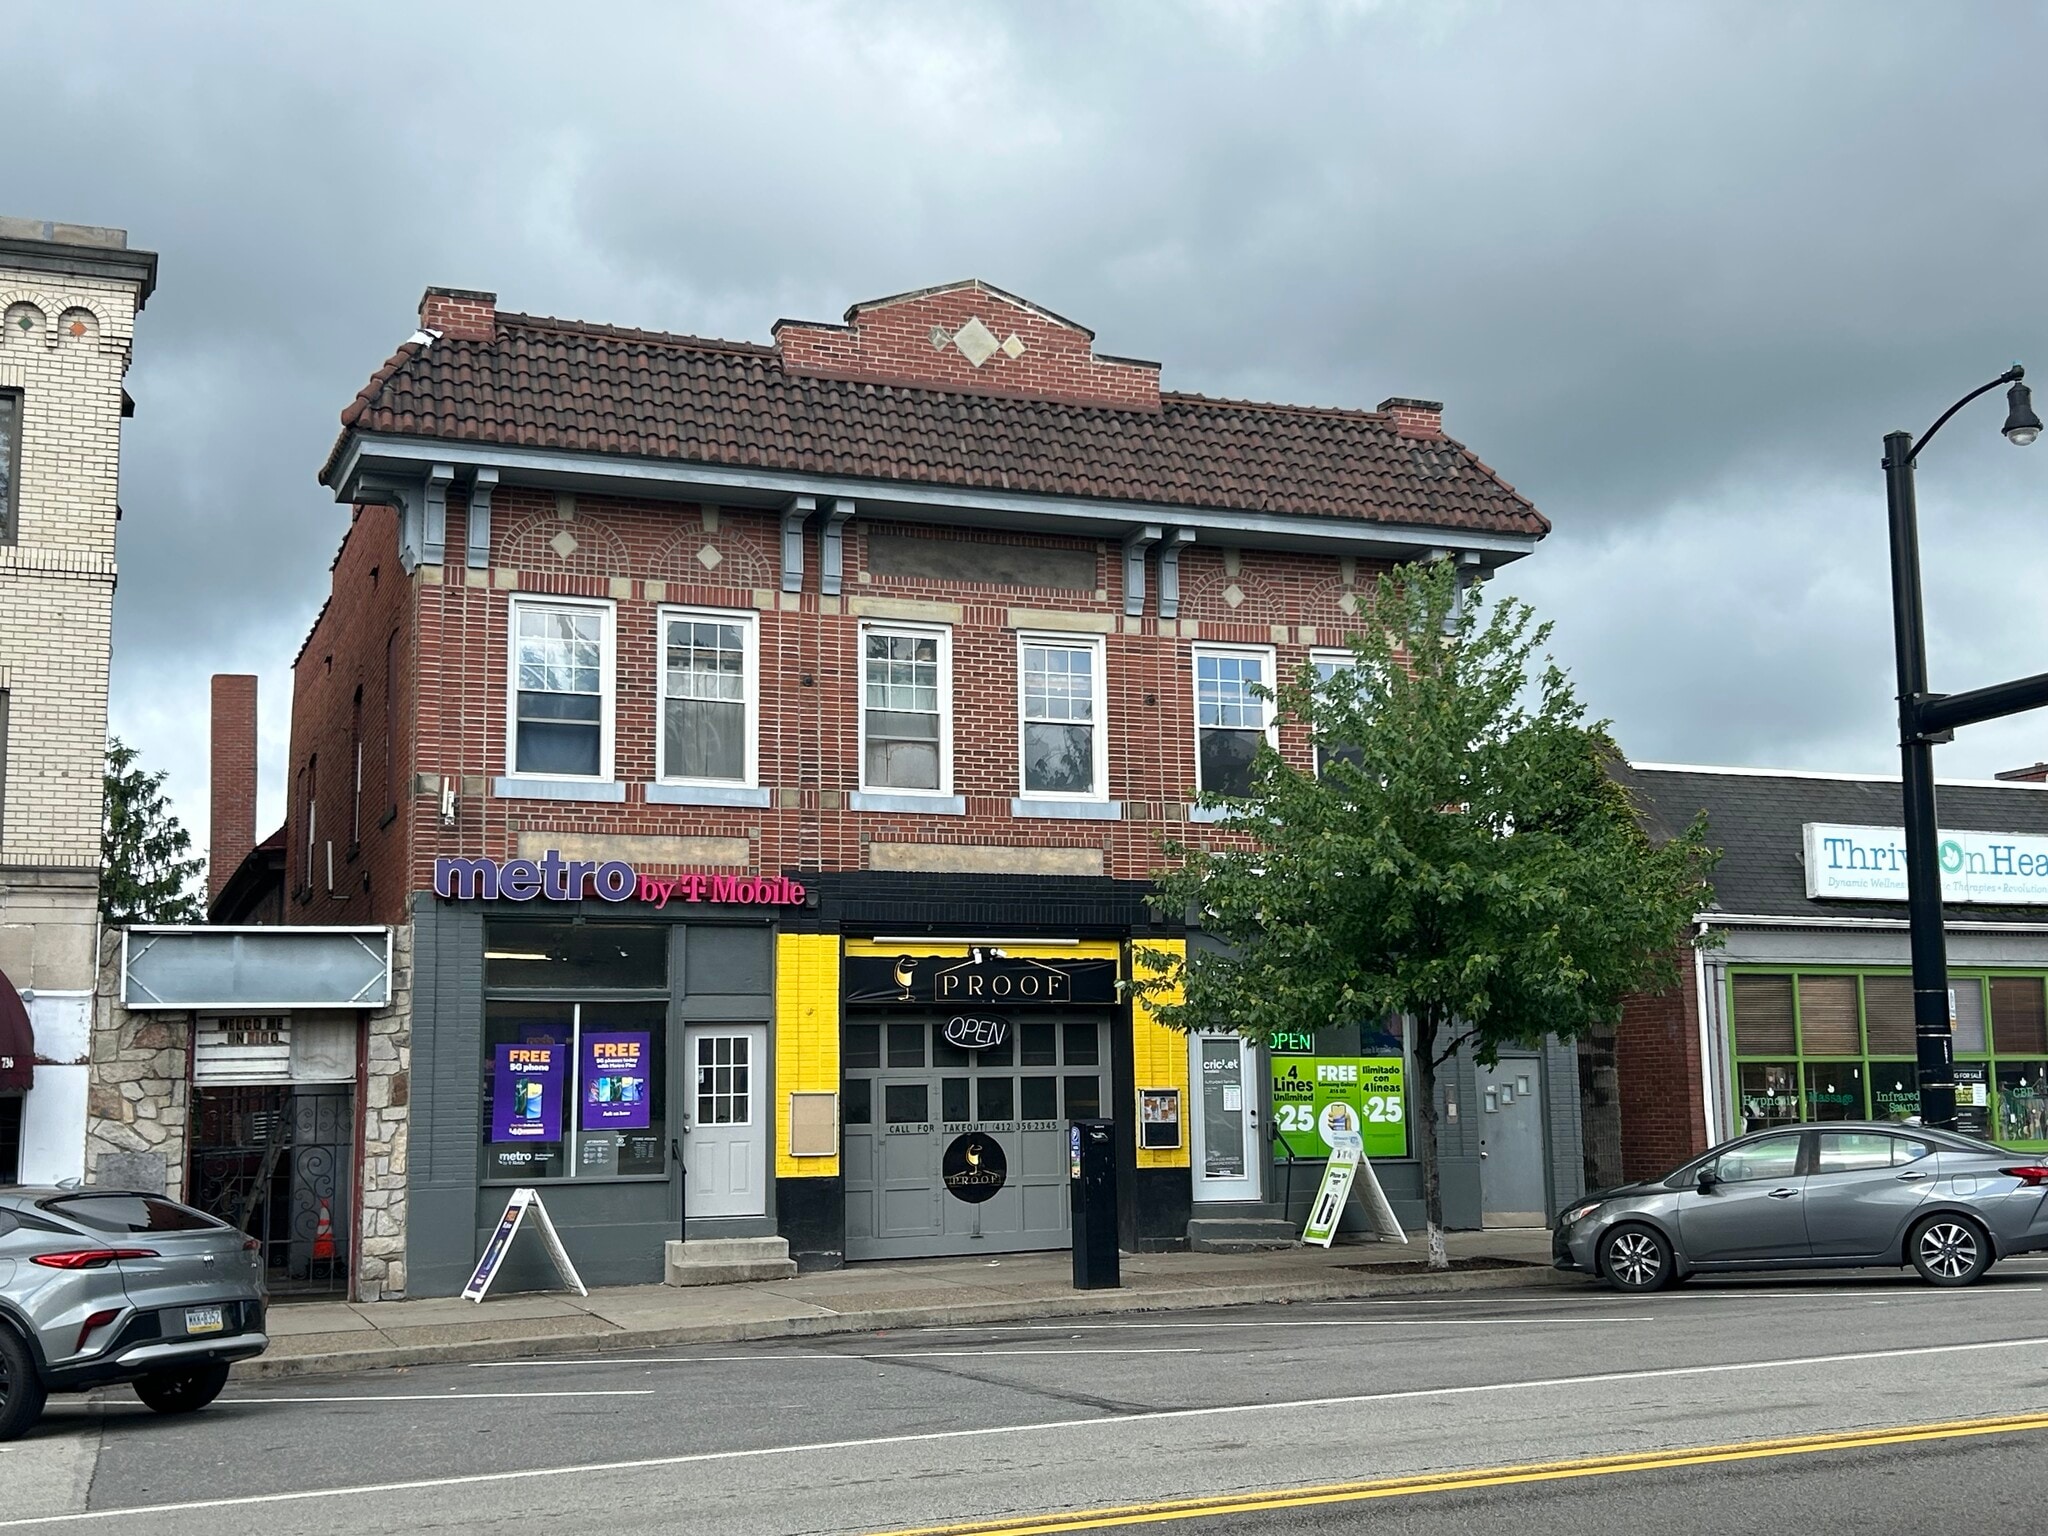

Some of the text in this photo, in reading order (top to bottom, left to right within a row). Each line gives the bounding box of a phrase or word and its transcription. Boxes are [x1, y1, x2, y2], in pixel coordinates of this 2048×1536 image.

[434, 849, 636, 902] metro
[640, 874, 674, 910] by
[1828, 877, 1868, 892] Dynamic
[1870, 878, 1906, 889] Wellnes
[1953, 882, 1996, 894] Therapies
[943, 975, 1063, 996] PROOF
[948, 1016, 1006, 1045] OPEN
[509, 1050, 551, 1063] FREE
[594, 1043, 640, 1057] FREE
[1, 1056, 14, 1069] 736
[510, 1063, 549, 1073] 5G phone
[1203, 1058, 1239, 1070] cricket
[1288, 1065, 1298, 1080] 4
[1317, 1065, 1357, 1082] FREE
[1362, 1066, 1400, 1074] Ilimitado
[1273, 1077, 1314, 1092] Lines
[1373, 1075, 1389, 1083] con
[1274, 1093, 1314, 1102] Unlimited
[1808, 1092, 1854, 1105] Massage
[1876, 1091, 1920, 1102] Infrared
[2013, 1087, 2034, 1098] CBD
[1363, 1096, 1402, 1123] $25
[1889, 1102, 1920, 1113] Sauna
[1274, 1104, 1315, 1131] $25
[889, 1124, 910, 1133] CALL
[917, 1124, 935, 1132] FOR
[500, 1151, 532, 1161] metro
[952, 1175, 999, 1185] PROOF
